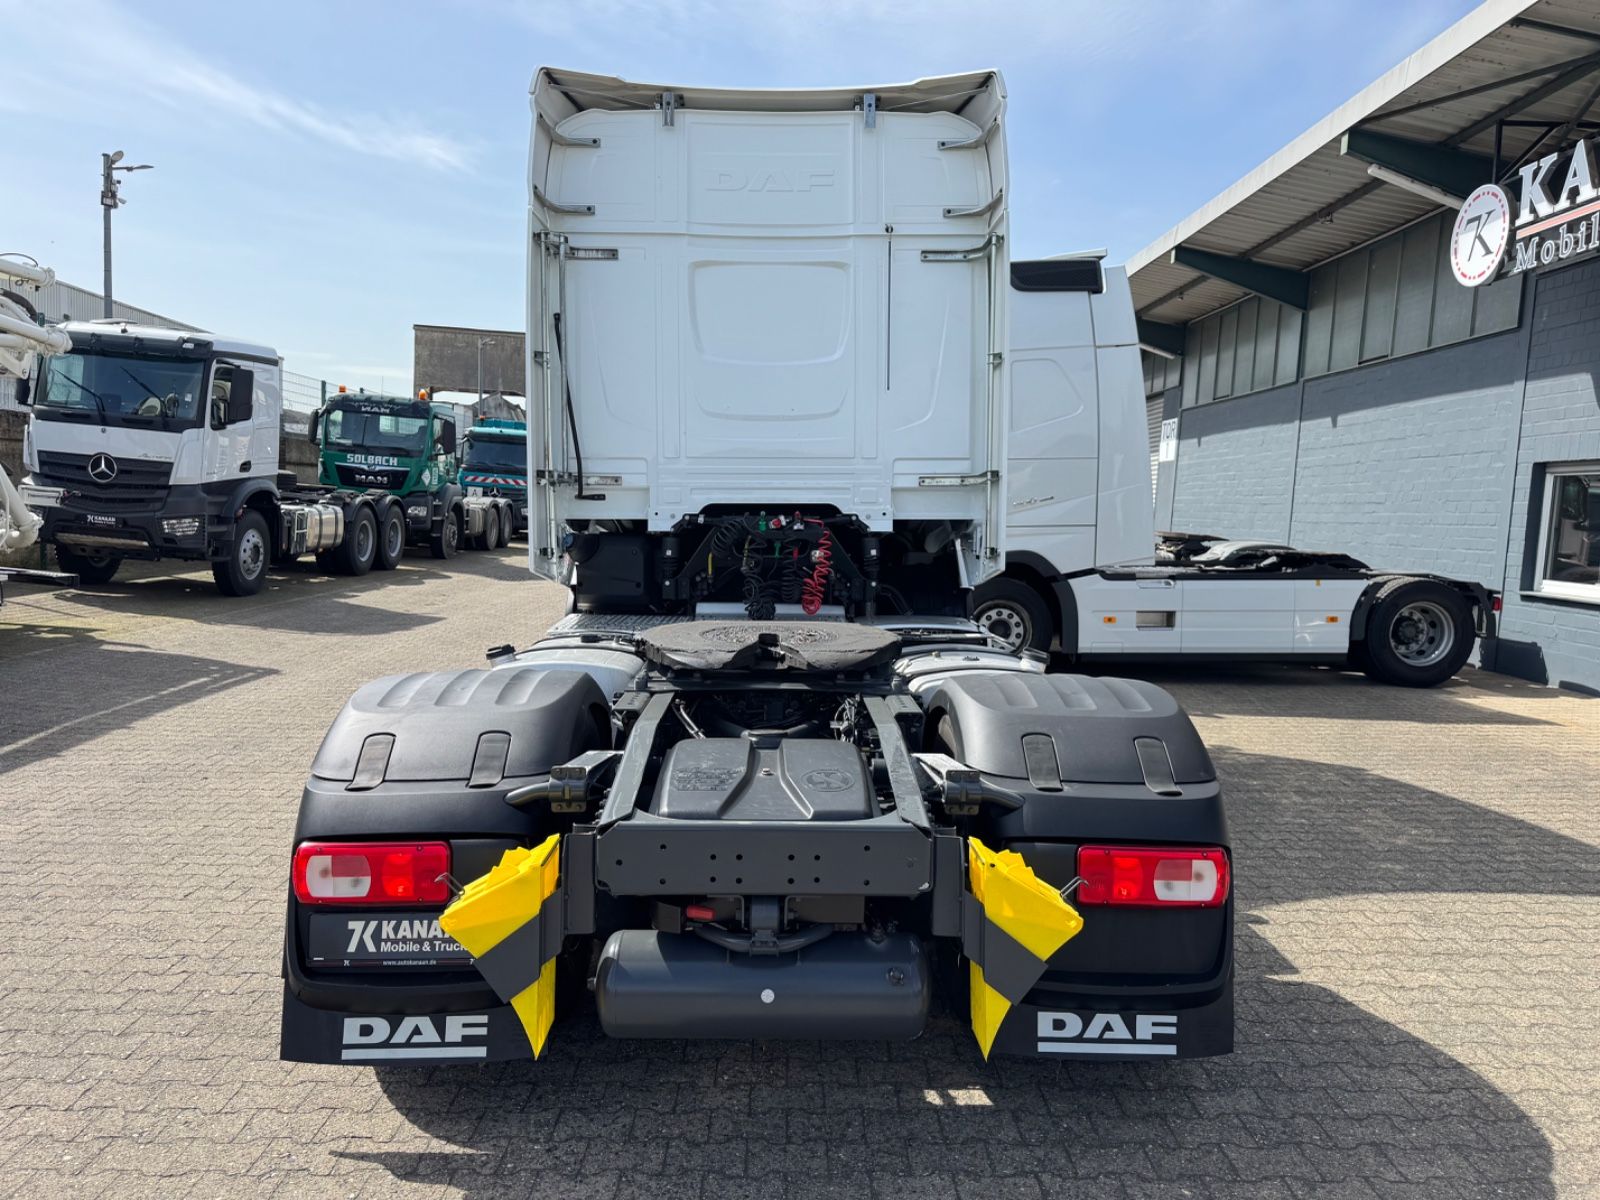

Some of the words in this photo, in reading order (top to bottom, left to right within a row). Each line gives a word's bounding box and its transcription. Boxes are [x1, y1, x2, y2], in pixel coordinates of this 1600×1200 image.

[705, 168, 835, 193] DAF
[1515, 139, 1600, 226] KA
[346, 453, 398, 466] SOLBACH
[354, 474, 388, 484] MAN
[381, 920, 452, 940] KANA
[380, 941, 420, 953] Mobile
[422, 940, 431, 952] &
[342, 1015, 488, 1045] DAF
[1037, 1011, 1178, 1040] DAF
